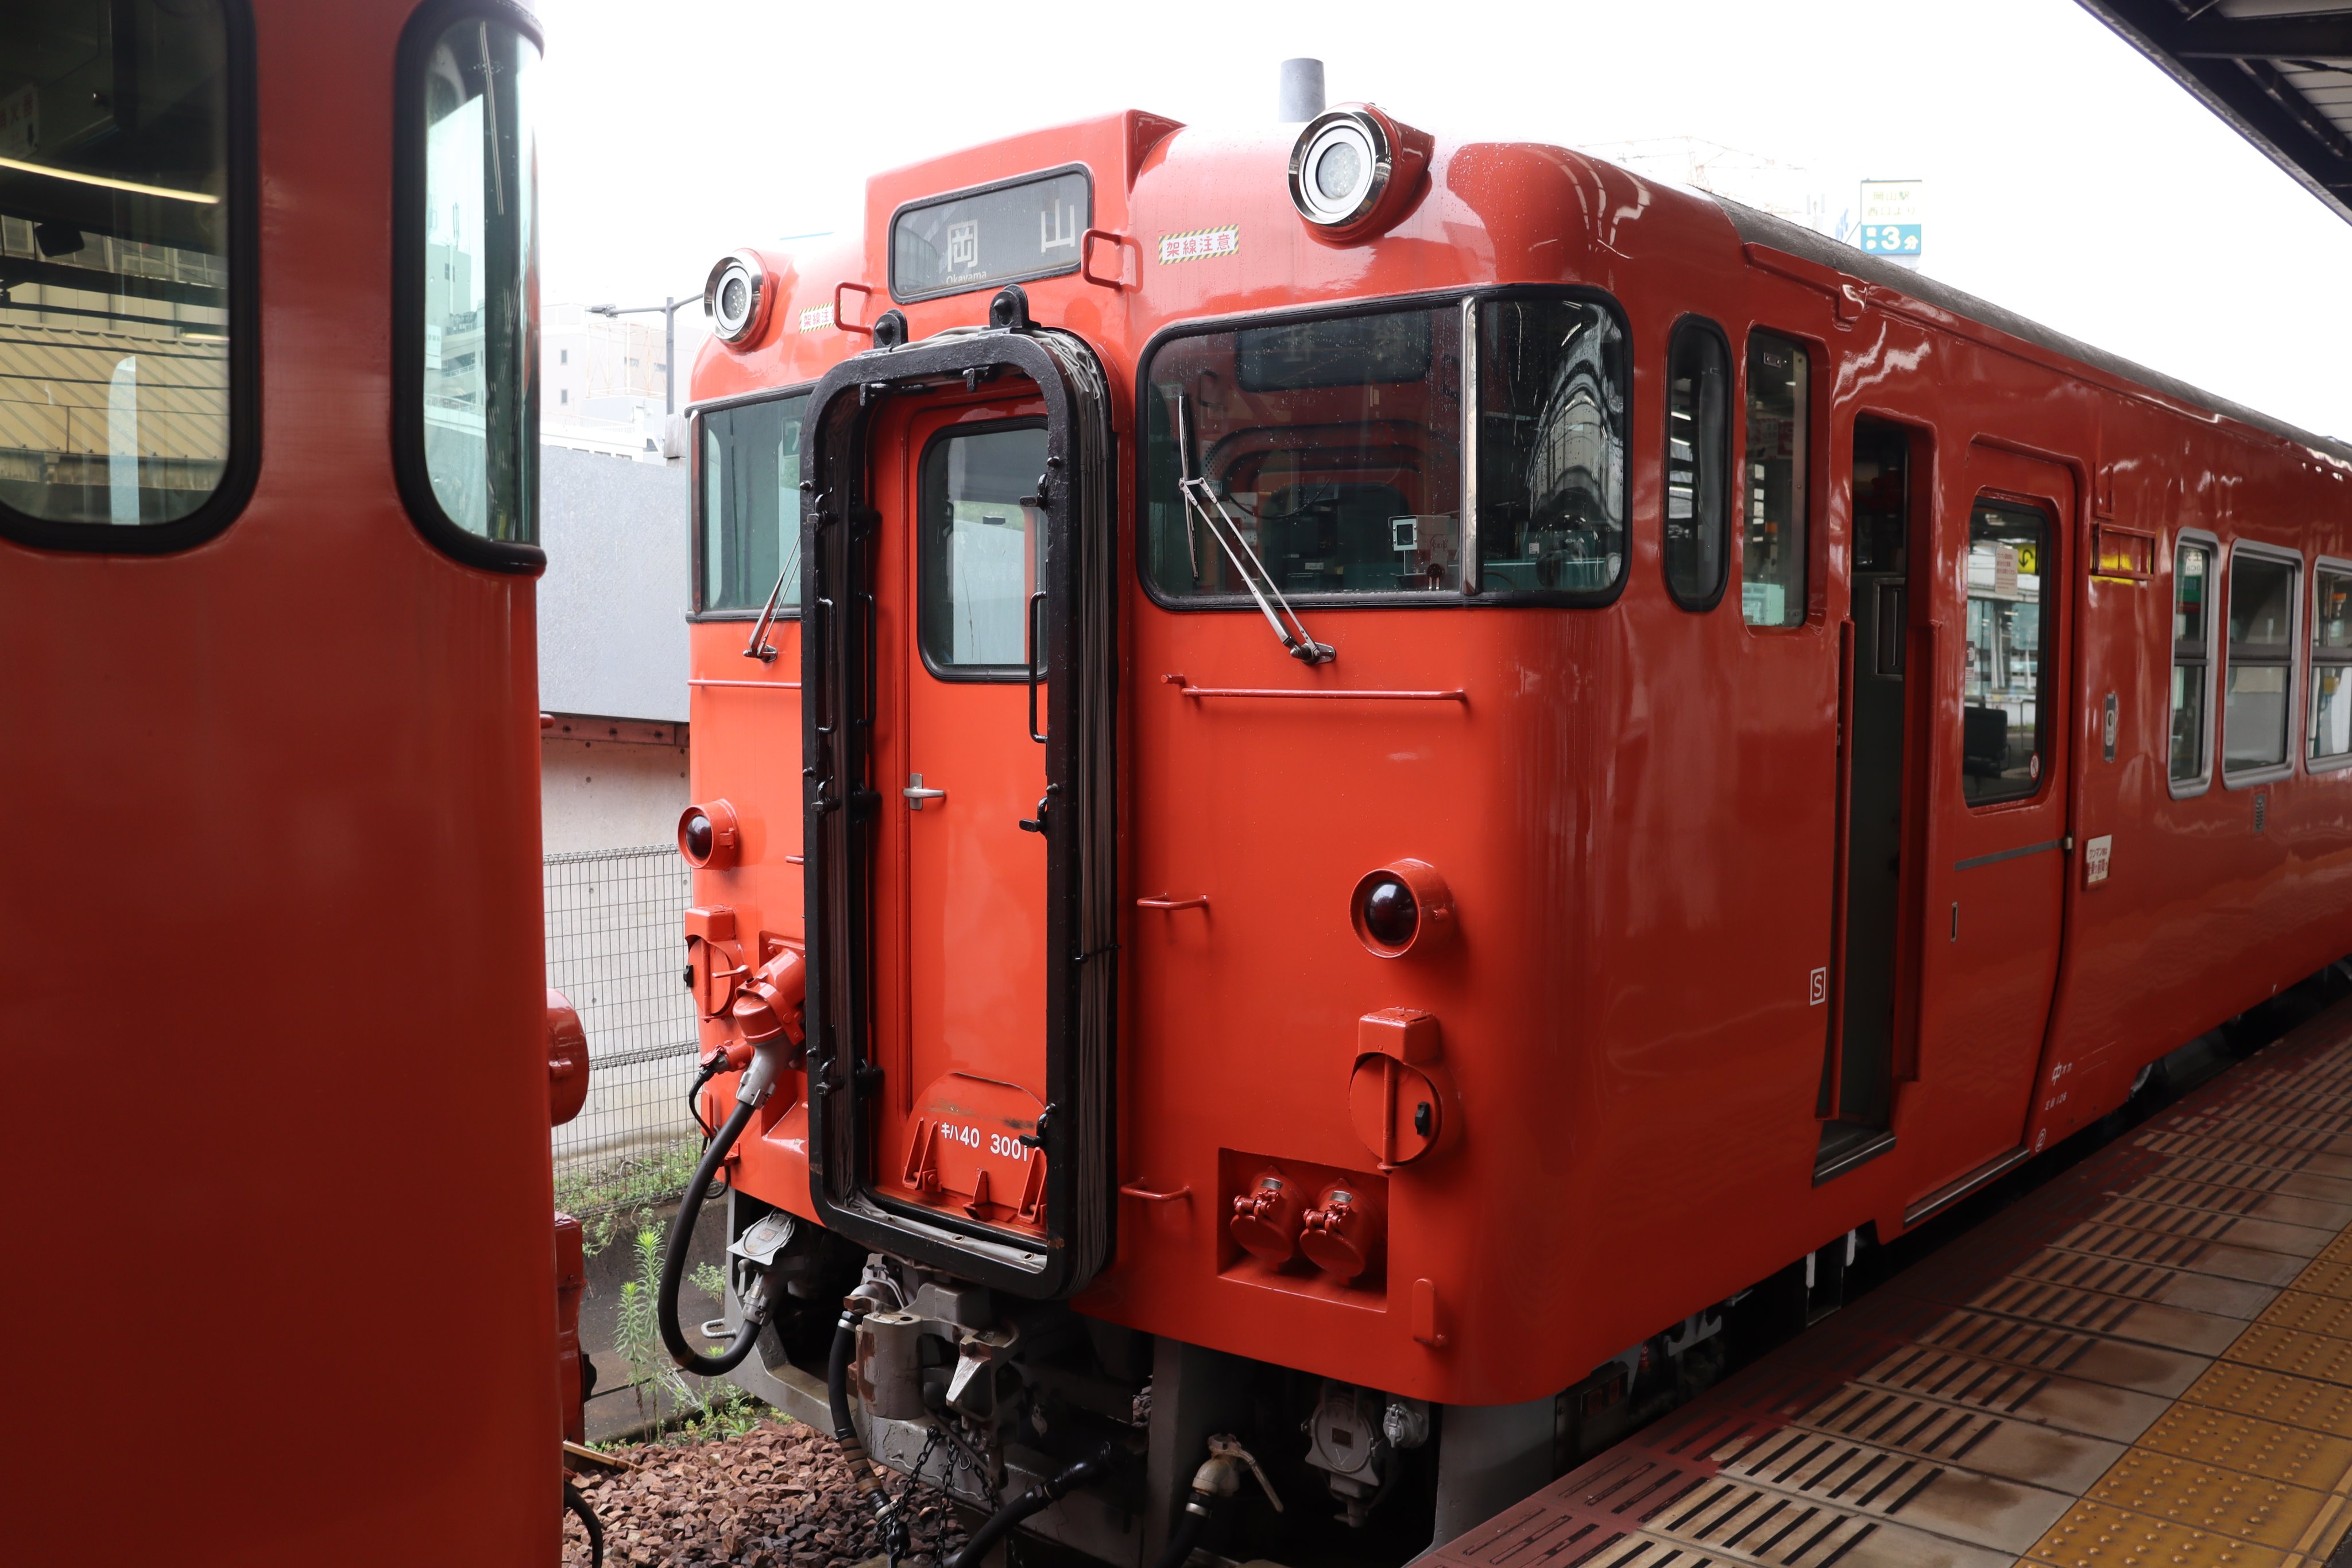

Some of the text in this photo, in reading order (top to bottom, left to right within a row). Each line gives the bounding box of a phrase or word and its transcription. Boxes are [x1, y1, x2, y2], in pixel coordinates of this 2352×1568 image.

[946, 199, 1076, 273] 岡山
[1166, 233, 1231, 257] 架線注意
[946, 270, 987, 285] Okayama
[1813, 974, 1823, 998] S
[941, 1122, 1028, 1162] キハ40 3001
